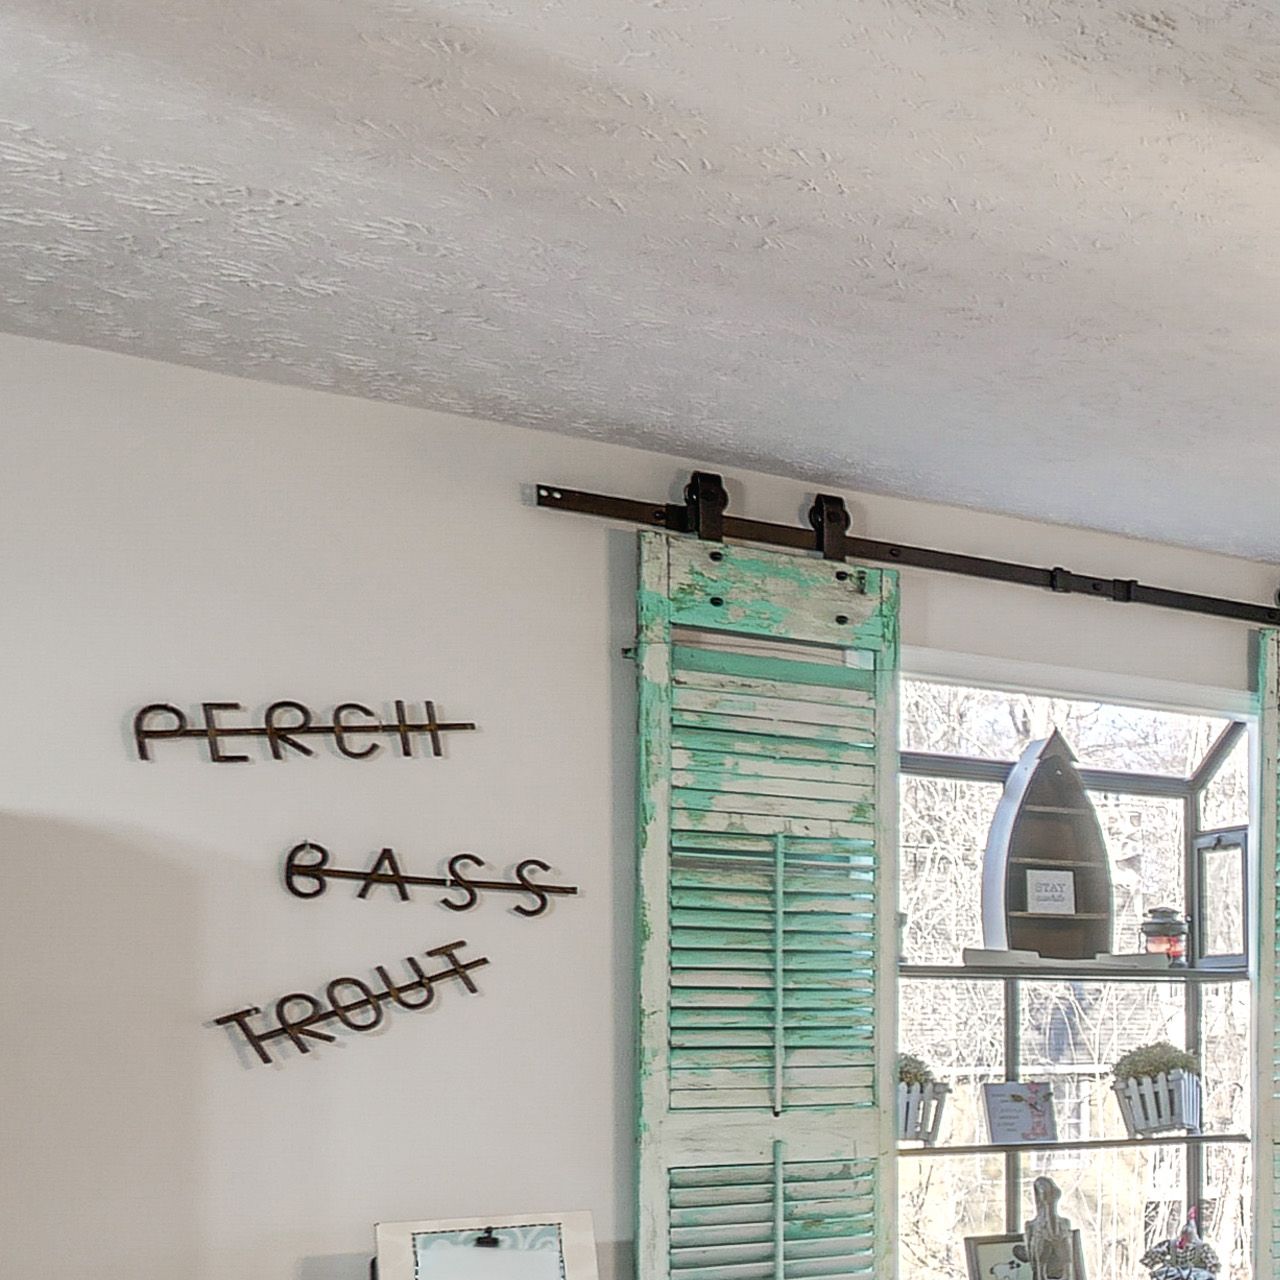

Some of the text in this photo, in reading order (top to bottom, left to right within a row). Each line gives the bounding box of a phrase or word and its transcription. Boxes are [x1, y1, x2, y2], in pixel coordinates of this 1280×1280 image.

[134, 699, 475, 762] PERCH
[285, 841, 577, 917] BASS
[216, 940, 488, 1064] TROUT
